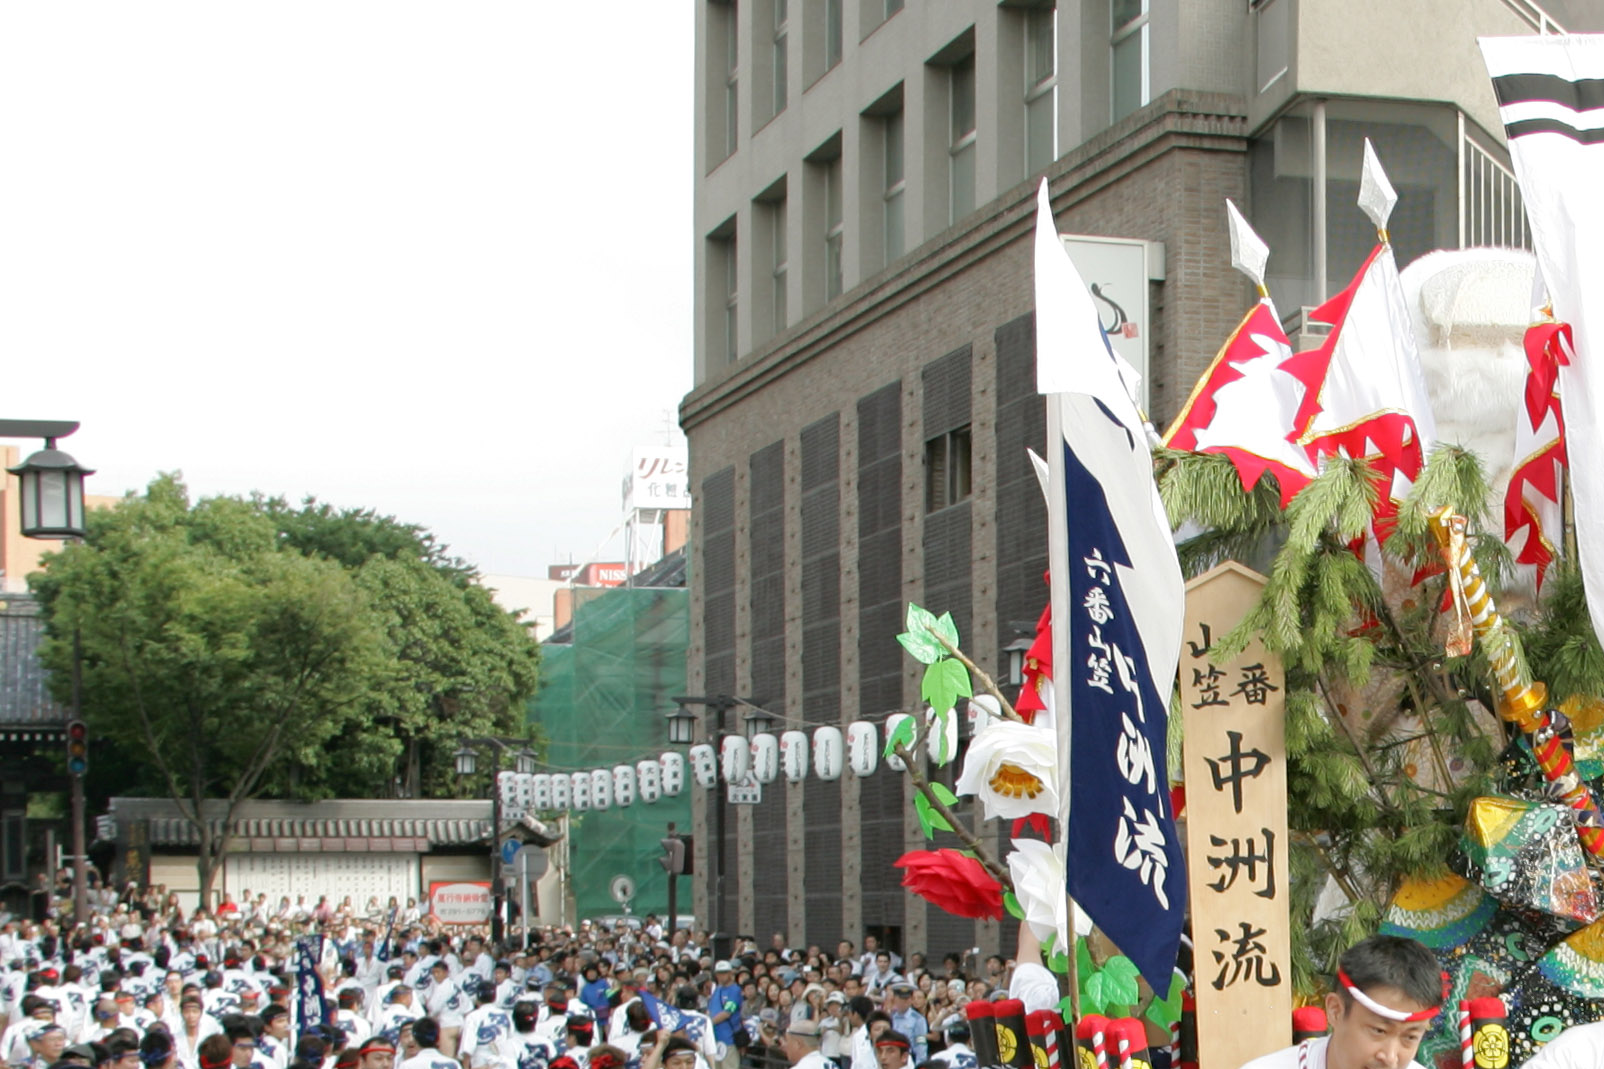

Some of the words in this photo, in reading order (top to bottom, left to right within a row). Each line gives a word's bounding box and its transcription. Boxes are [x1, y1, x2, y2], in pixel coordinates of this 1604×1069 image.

[638, 457, 688, 480] リレン
[599, 569, 628, 581] NISS
[1083, 547, 1114, 695] 六番山笠
[1186, 622, 1230, 710] 山笠
[1203, 730, 1282, 992] 中洲流
